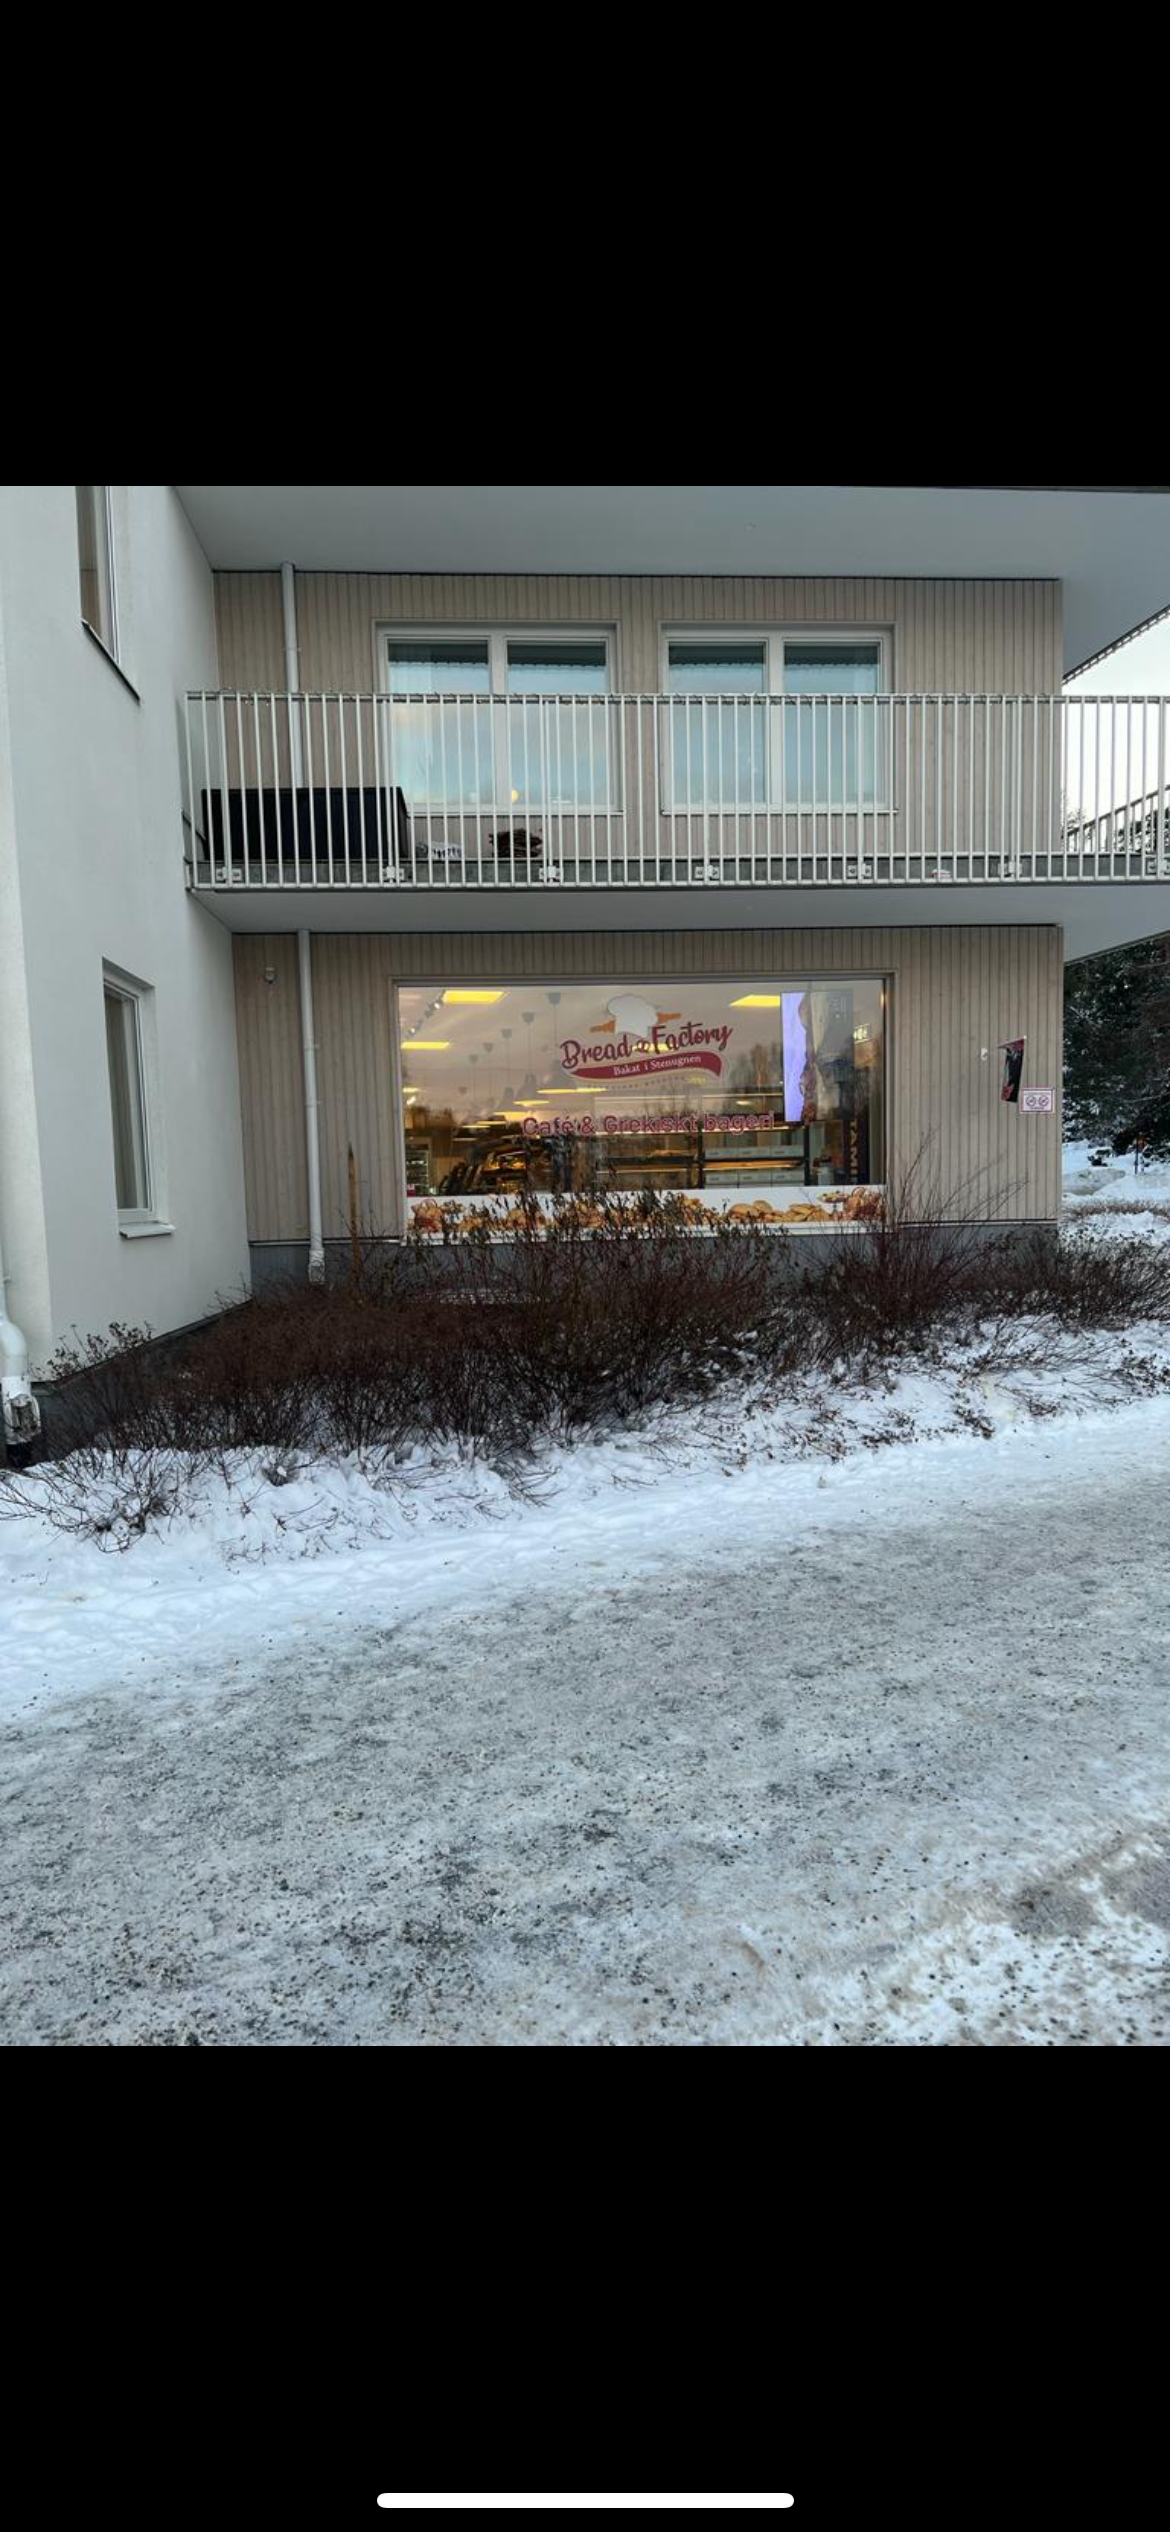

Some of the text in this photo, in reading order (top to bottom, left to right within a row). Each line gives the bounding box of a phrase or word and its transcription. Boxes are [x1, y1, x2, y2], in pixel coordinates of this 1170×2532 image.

[560, 1034, 632, 1069] Bread
[649, 1022, 733, 1054] Factory
[613, 1062, 640, 1076] Bakat
[650, 1055, 702, 1071] Stenugnen
[524, 1112, 774, 1135] Café & Grekiskt bageri
